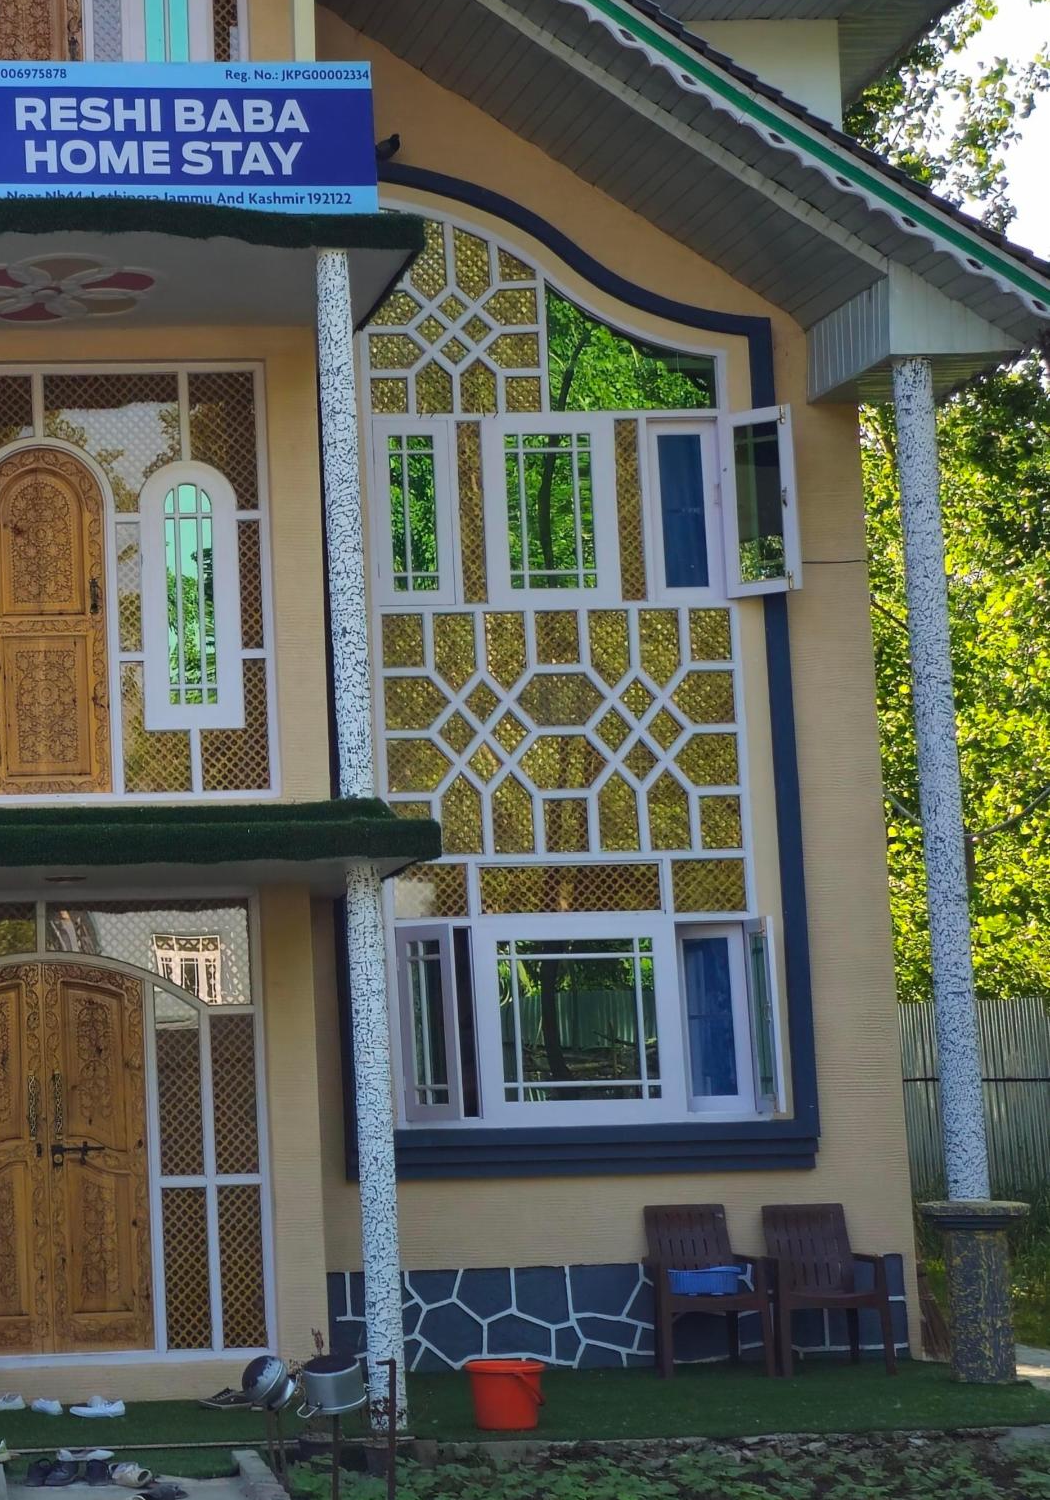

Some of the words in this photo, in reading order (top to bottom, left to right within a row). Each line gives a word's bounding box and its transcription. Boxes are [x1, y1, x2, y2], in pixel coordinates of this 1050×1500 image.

[225, 69, 250, 83] Reg.
[254, 70, 278, 80] No.:
[281, 69, 369, 81] JKPG00002334
[15, 97, 161, 133] RESHI
[174, 98, 310, 133] BABA
[25, 139, 171, 175] HOME
[181, 141, 303, 176] STAY
[217, 191, 244, 204] And
[249, 191, 305, 205] Kashmir
[308, 192, 352, 205] 192122
